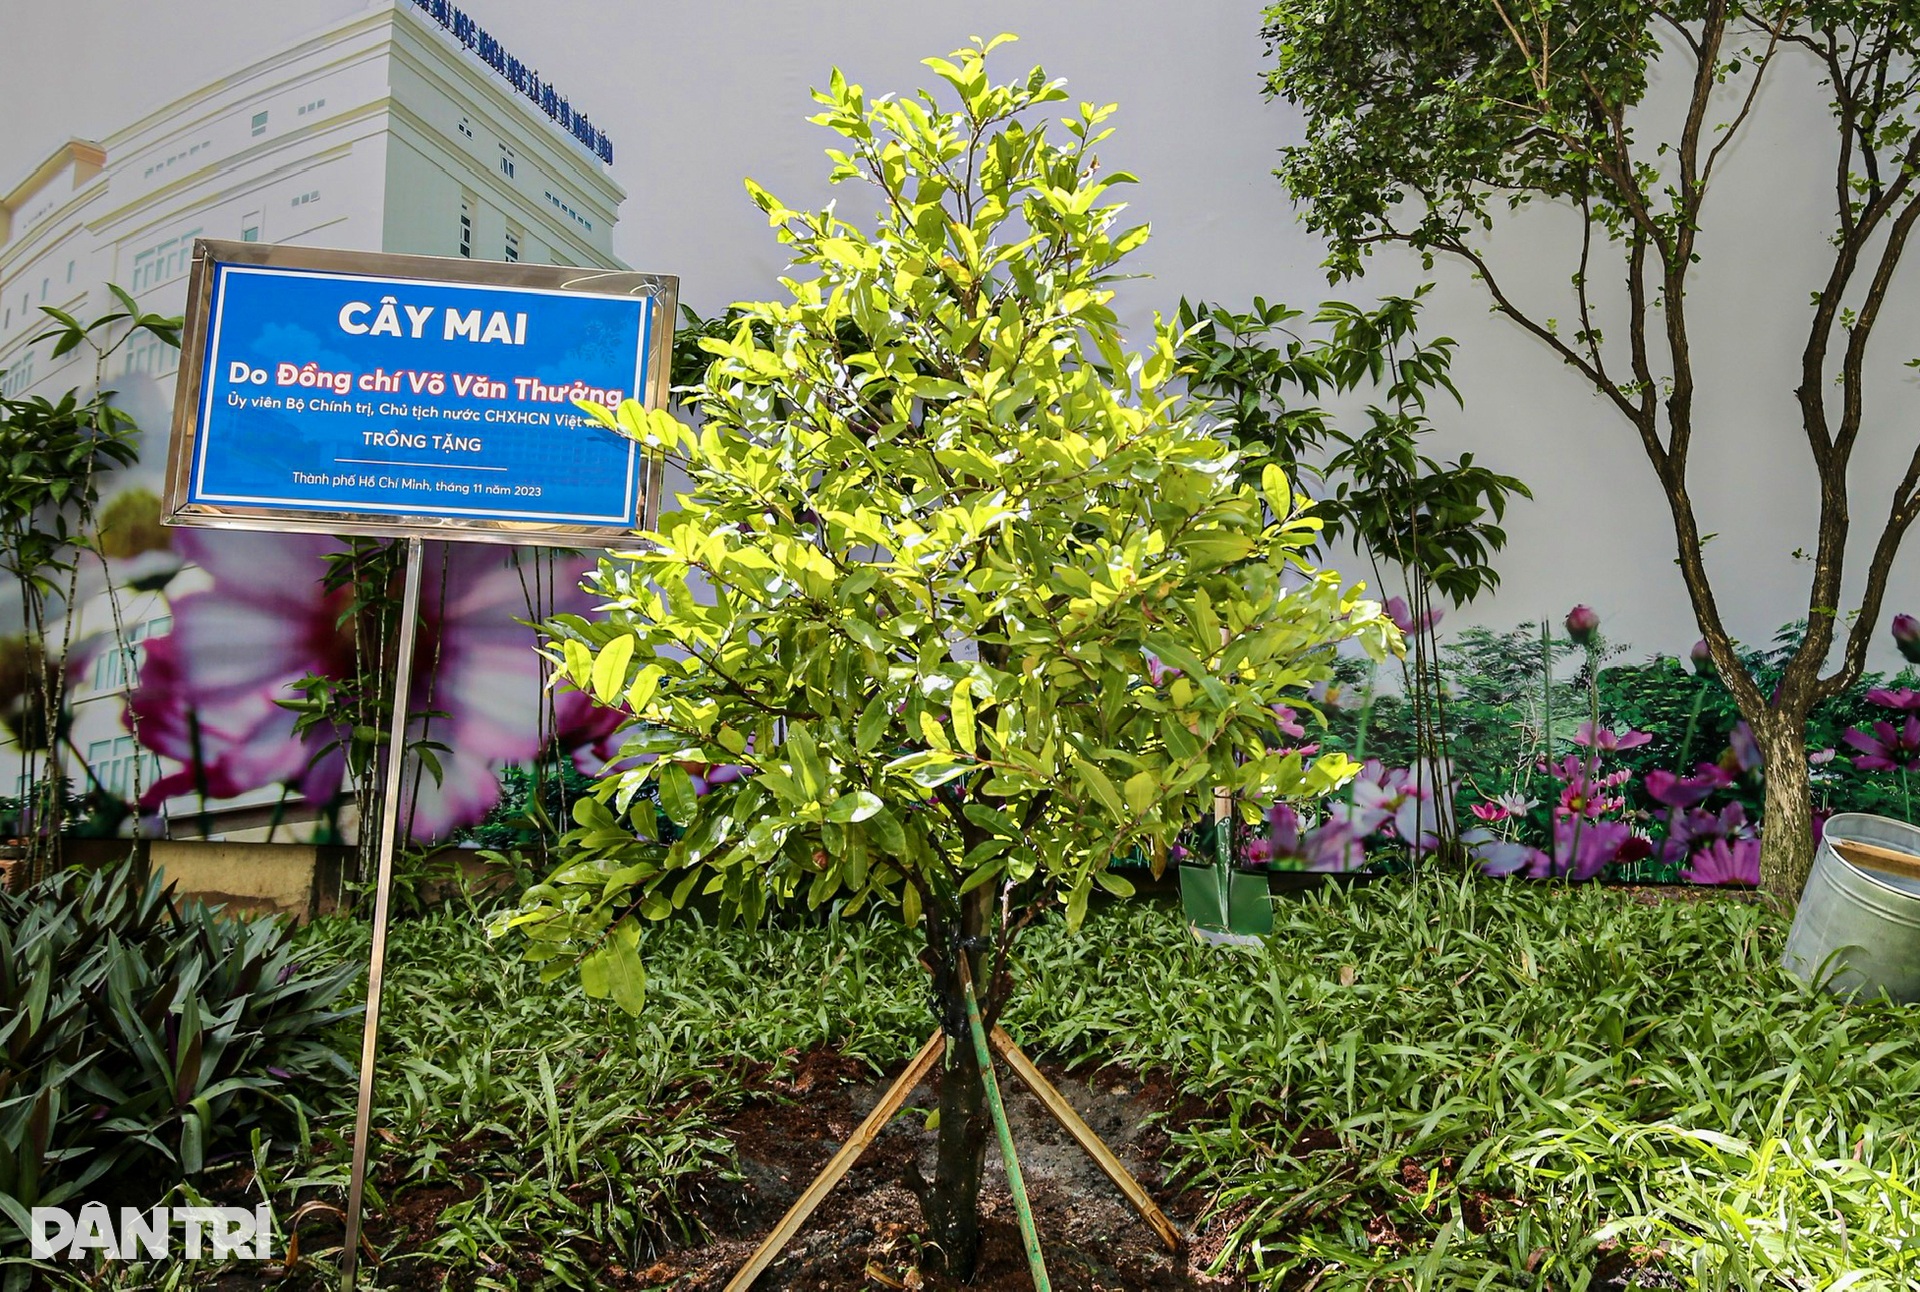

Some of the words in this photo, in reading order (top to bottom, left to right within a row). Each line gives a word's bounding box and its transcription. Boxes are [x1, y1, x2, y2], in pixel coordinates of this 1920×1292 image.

[338, 296, 435, 339] CÂY
[443, 309, 527, 345] MAI
[228, 361, 268, 385] Do
[277, 362, 351, 394] Đồng
[359, 367, 403, 392] chí
[408, 371, 445, 395] Võ
[453, 374, 506, 399] Văn
[515, 378, 622, 411] Thưởng
[228, 390, 247, 409] Ủy
[251, 397, 282, 409] viên
[286, 398, 305, 413] Bộ
[309, 398, 352, 413] Chính
[356, 402, 375, 417] trị,
[379, 404, 408, 417] Chủ
[412, 405, 439, 421] tịch
[443, 409, 481, 422] nước
[484, 410, 550, 426] CHXHCN
[555, 413, 582, 430] Việt
[362, 429, 427, 449] TRỒNG
[431, 433, 482, 453] TẶNG
[292, 471, 330, 485] Thành
[332, 475, 356, 488] phố
[358, 475, 376, 488] Hồ
[378, 476, 398, 489] Chí
[402, 478, 432, 491] Minh,
[435, 481, 470, 495] tháng
[473, 483, 482, 493] 11
[485, 484, 511, 495] năm
[514, 485, 542, 497] 2023
